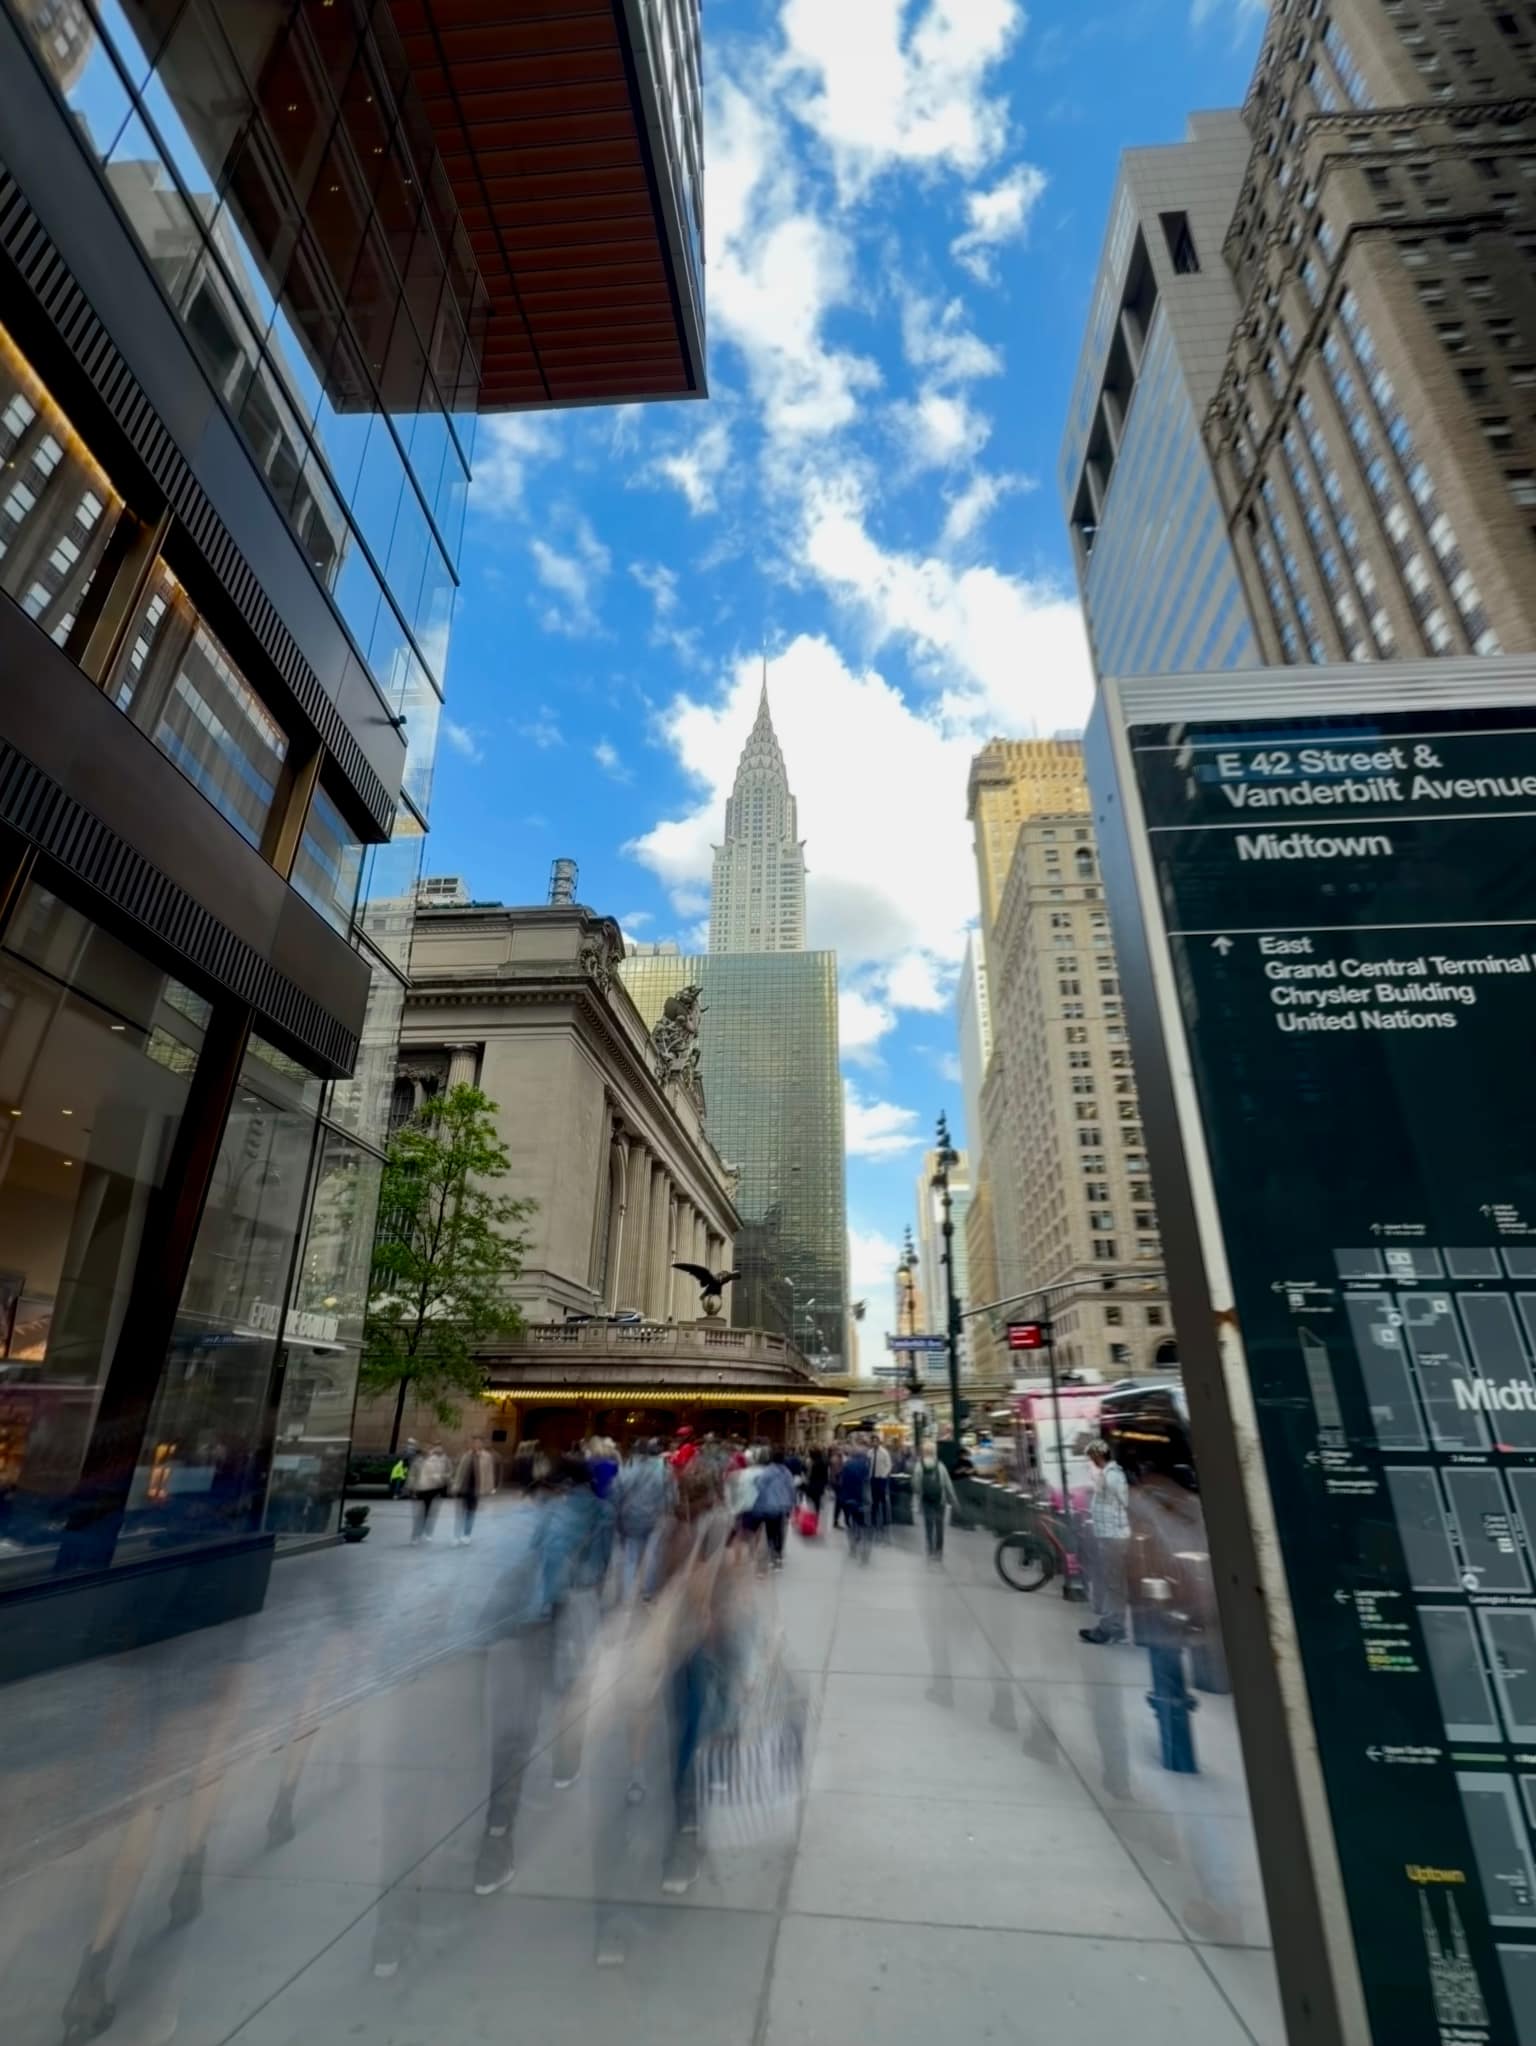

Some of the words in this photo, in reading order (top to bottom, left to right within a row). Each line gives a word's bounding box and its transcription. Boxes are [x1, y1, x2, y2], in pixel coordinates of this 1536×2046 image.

[1217, 753, 1244, 778] E
[1250, 751, 1294, 776] 42
[1299, 745, 1407, 774] Street
[1414, 744, 1443, 769] &
[1221, 777, 1405, 808] Vanderbilt
[1411, 775, 1536, 801] Avenue
[1235, 833, 1393, 861] Midtown
[1258, 936, 1314, 955] East
[1264, 959, 1337, 980] Grand
[1340, 957, 1428, 978] Central
[1429, 953, 1532, 976] Terminal
[1270, 985, 1372, 1008] Chrysler
[1375, 982, 1477, 1005] Building
[1276, 1010, 1358, 1032] United
[1360, 1009, 1457, 1030] Nations
[1451, 1377, 1536, 1411] Midt
